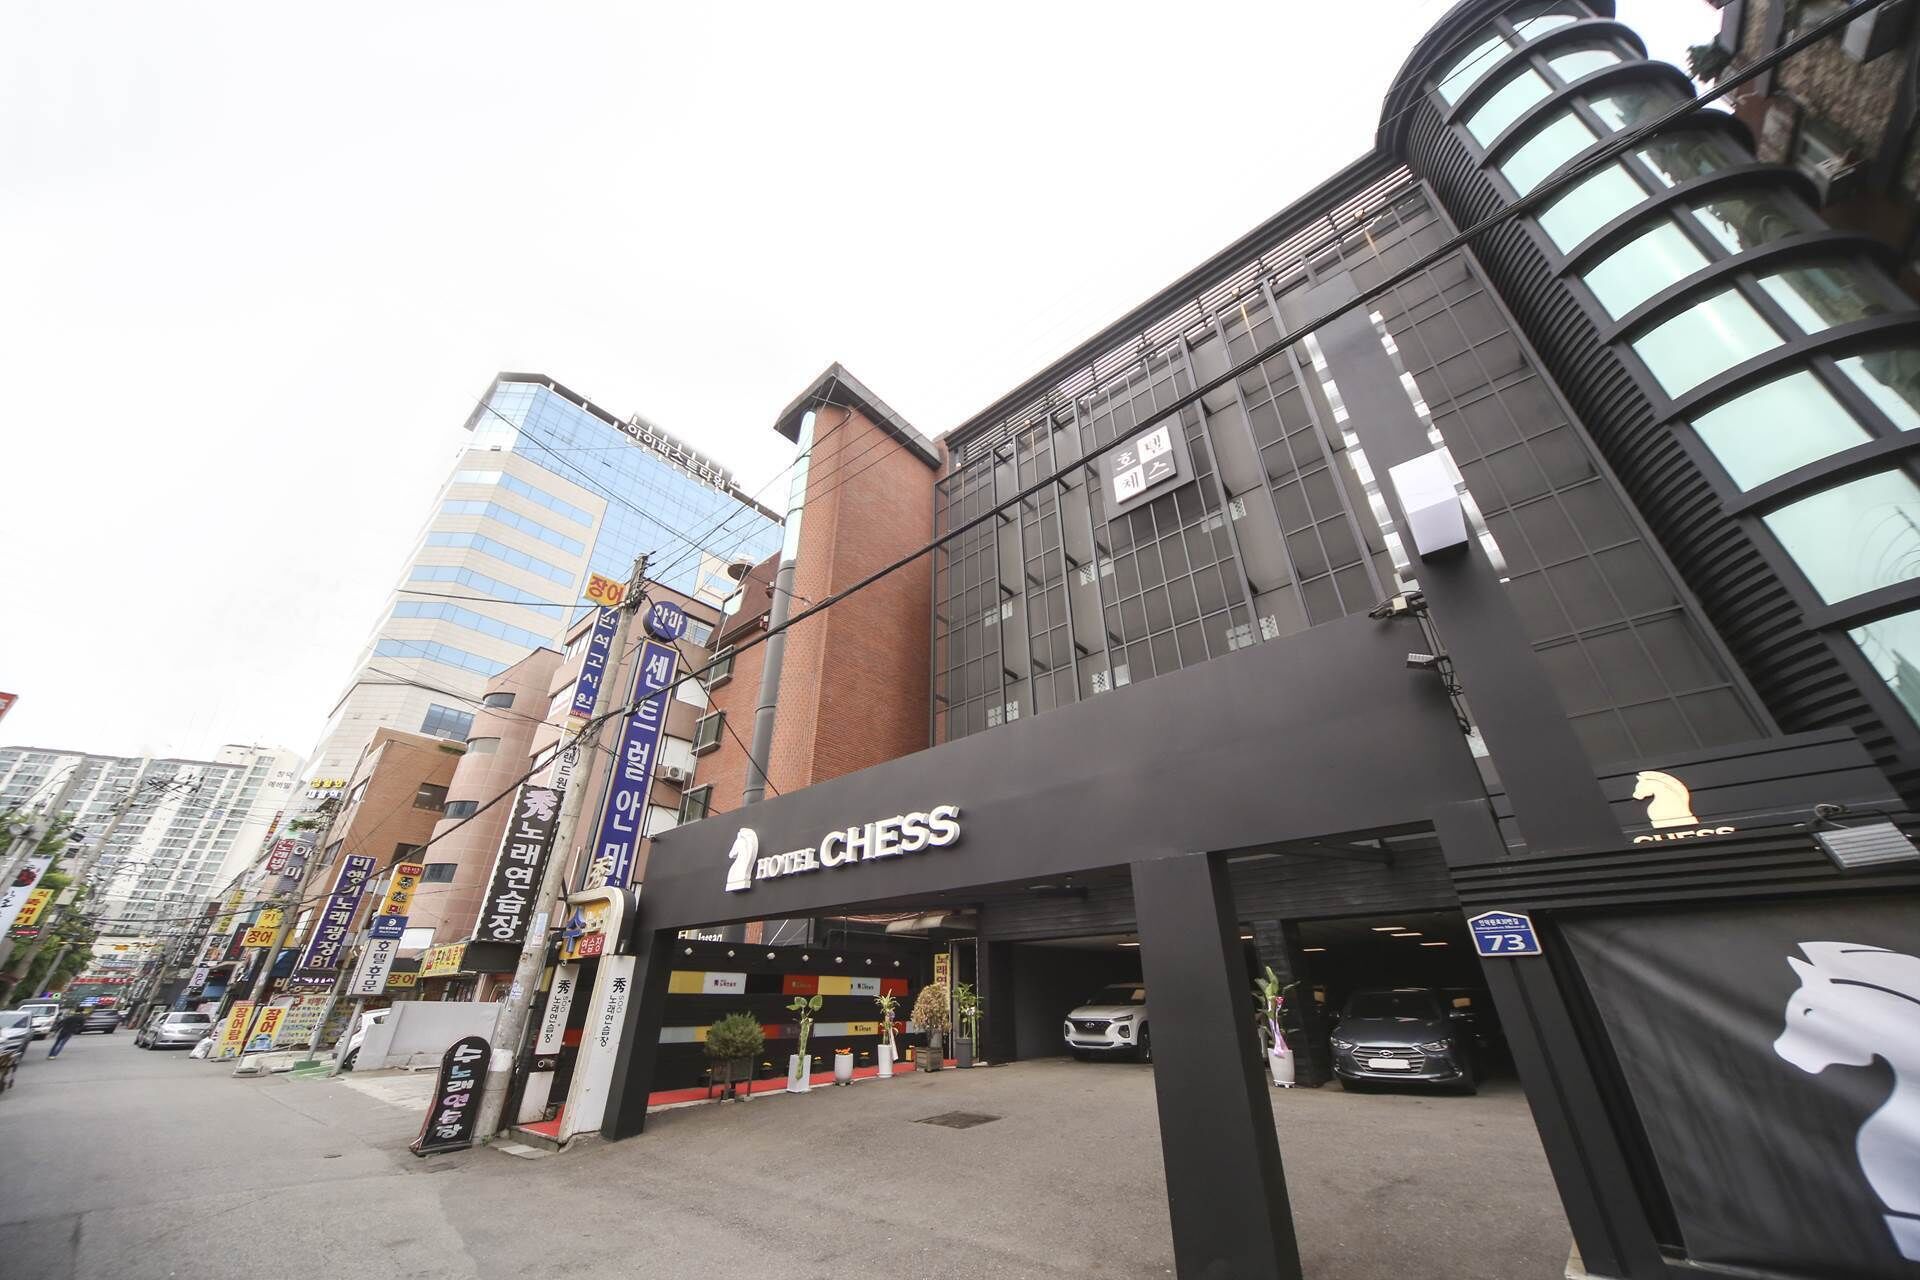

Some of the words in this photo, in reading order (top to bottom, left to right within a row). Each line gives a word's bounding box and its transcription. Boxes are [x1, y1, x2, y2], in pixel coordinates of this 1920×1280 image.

[626, 423, 725, 490] 아이퍼스트타워
[1116, 434, 1165, 471] 호텔
[1121, 461, 1170, 489] 체스
[588, 575, 624, 602] 장어
[652, 604, 683, 636] 안마
[521, 790, 559, 822] 秀
[756, 848, 820, 880] HOTEL
[819, 805, 961, 869] CHESS
[488, 820, 545, 940] 노래연습장
[247, 929, 273, 944] 장어
[580, 936, 603, 954] 연습장
[1484, 933, 1527, 951] 73
[309, 956, 329, 968] B1
[362, 940, 391, 992] 호텔후문
[387, 974, 416, 986] 장어
[557, 979, 571, 994] 秀
[612, 977, 627, 994] 秀
[260, 1008, 282, 1033] 장어
[544, 995, 561, 1043] 노래연습장
[600, 995, 617, 1048] 노래연습장
[436, 1065, 475, 1139] 노래연습장
